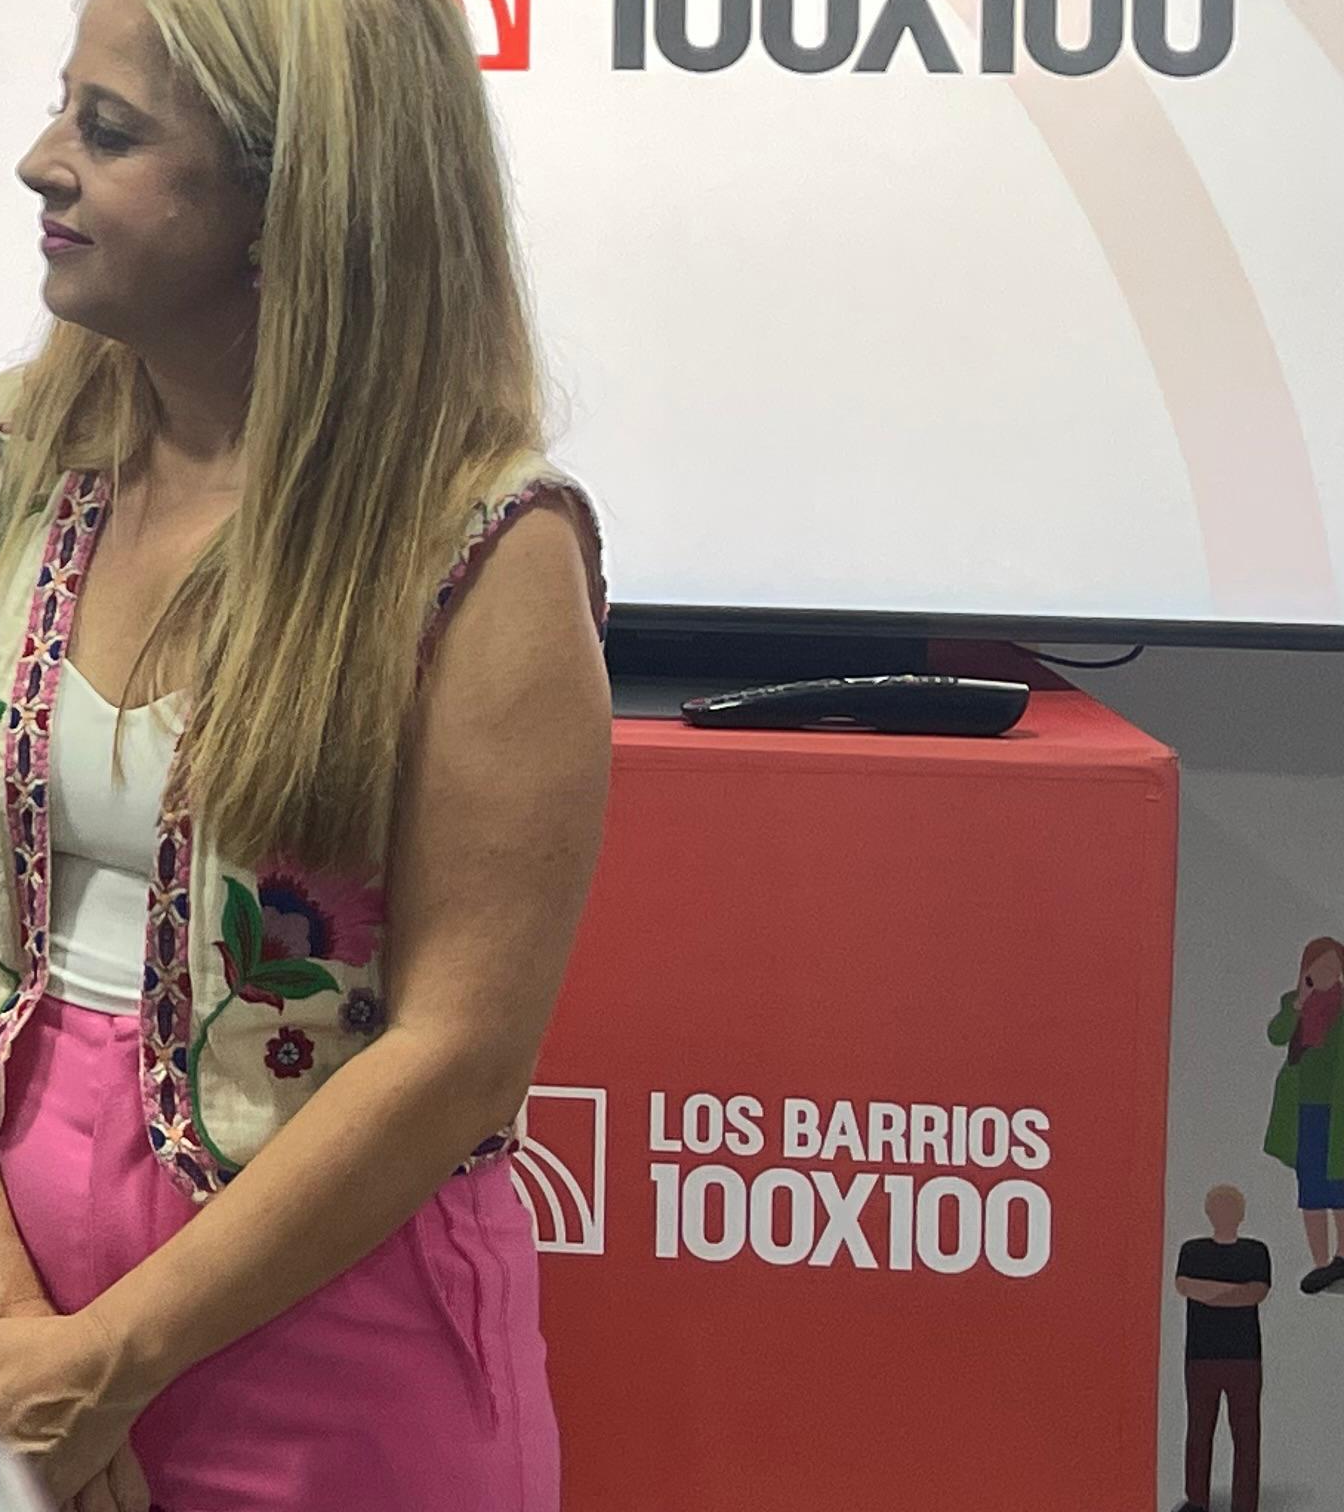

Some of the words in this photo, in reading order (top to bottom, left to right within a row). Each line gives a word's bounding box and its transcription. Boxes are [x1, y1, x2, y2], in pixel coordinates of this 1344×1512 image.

[649, 1091, 765, 1157] LOS
[783, 1097, 1051, 1171] BARRIOS
[649, 1162, 1052, 1278] 100X100
